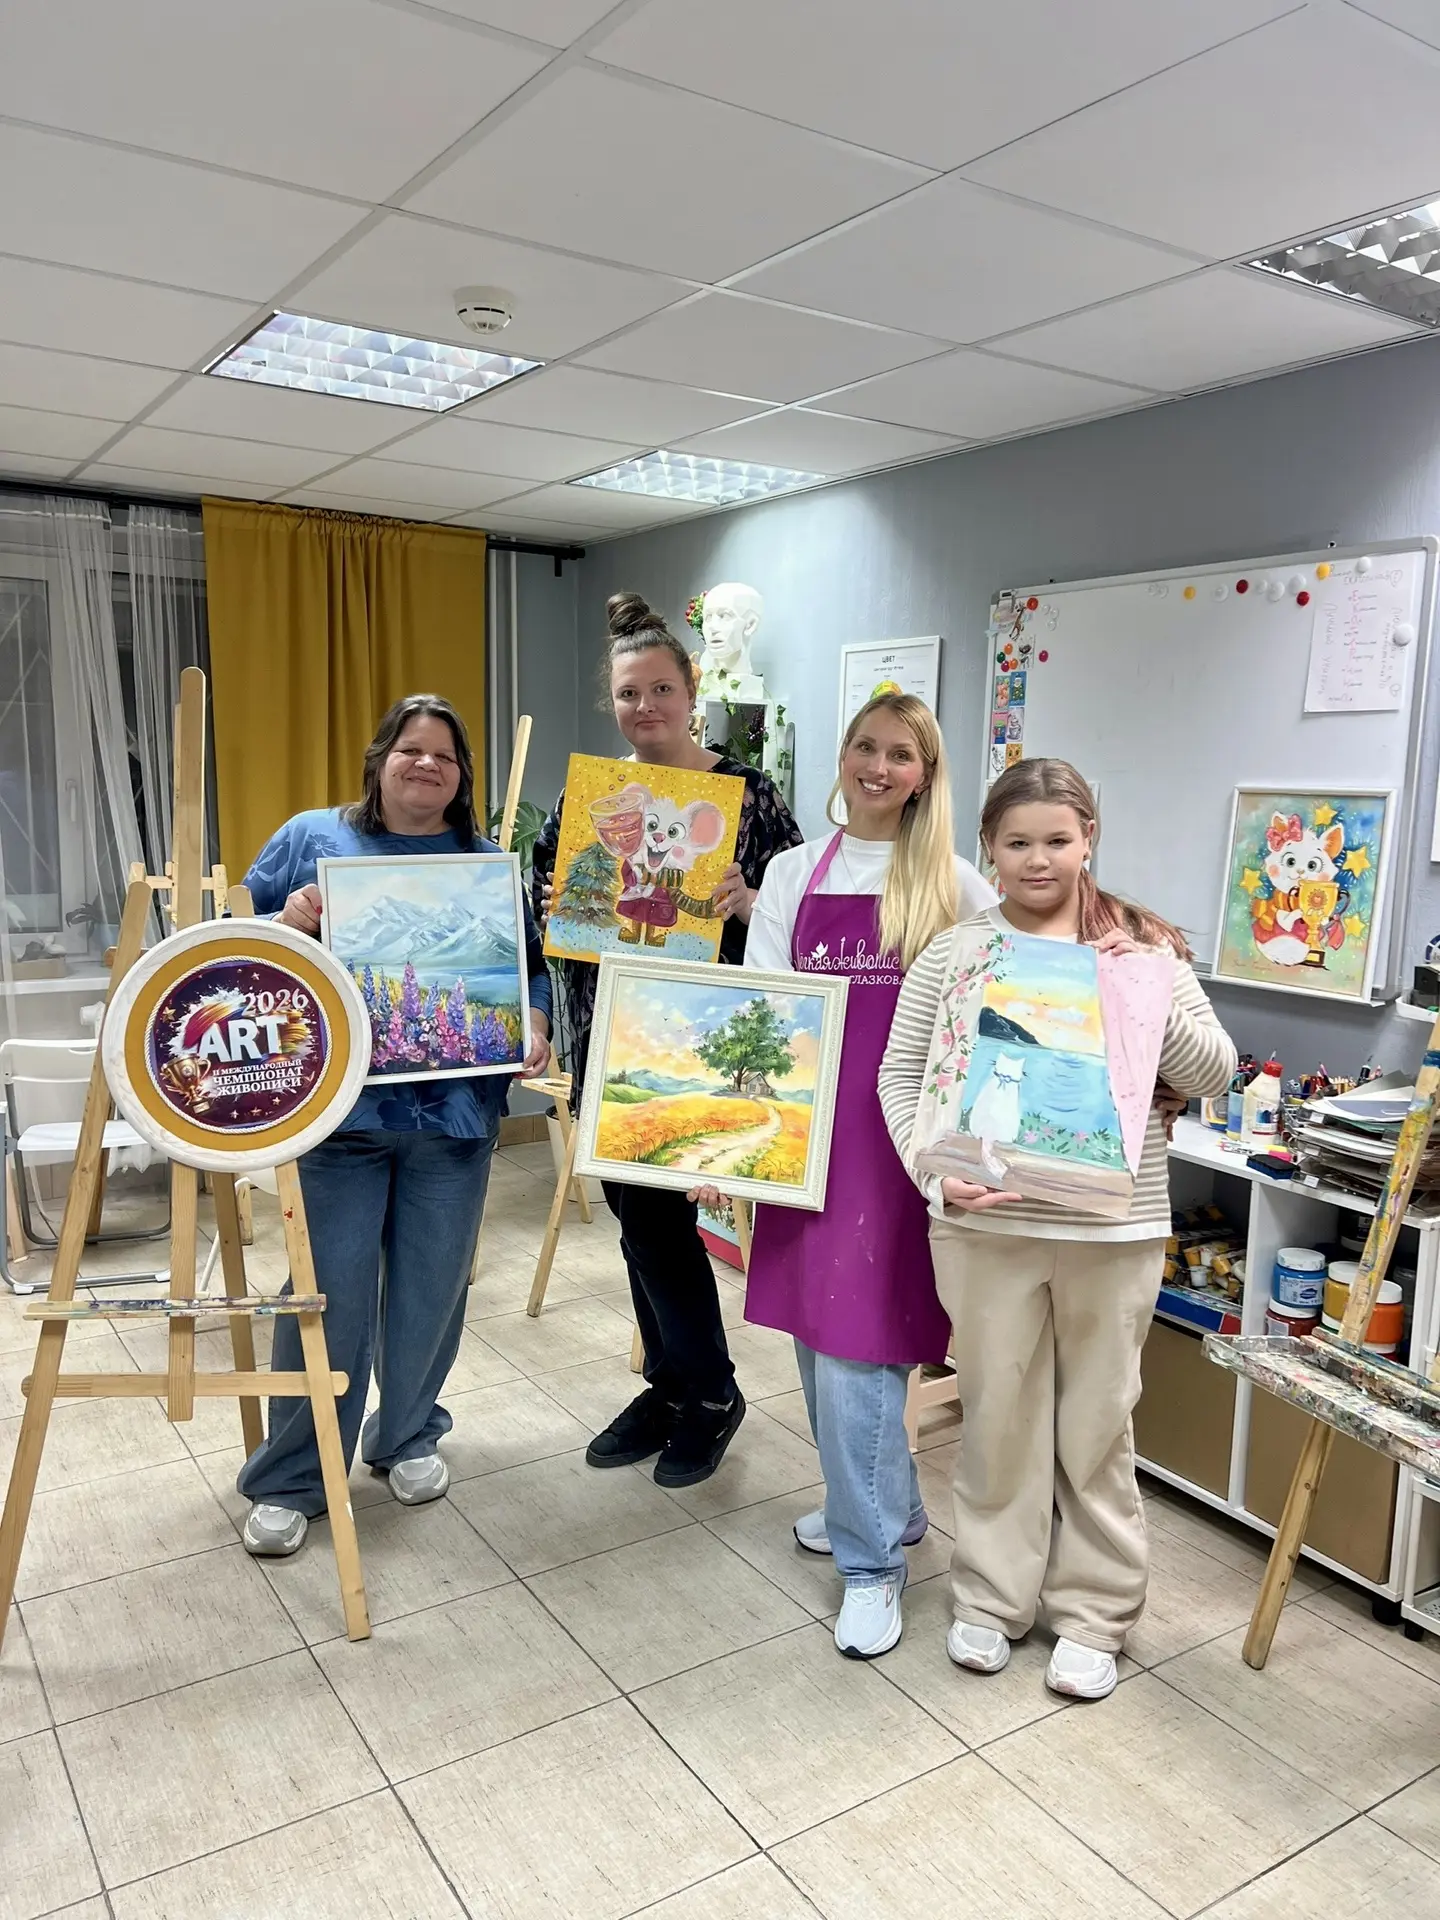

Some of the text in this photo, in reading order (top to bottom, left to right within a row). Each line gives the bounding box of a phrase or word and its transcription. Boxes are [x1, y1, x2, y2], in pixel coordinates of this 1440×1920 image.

[242, 988, 308, 1016] 2026
[199, 1016, 288, 1062] ART
[213, 1066, 304, 1086] ЧЕМПИОНАТ
[220, 1059, 302, 1075] МЕЖДУНАРОДНЫЙ
[217, 1077, 302, 1096] ЖИВОПИСИ
